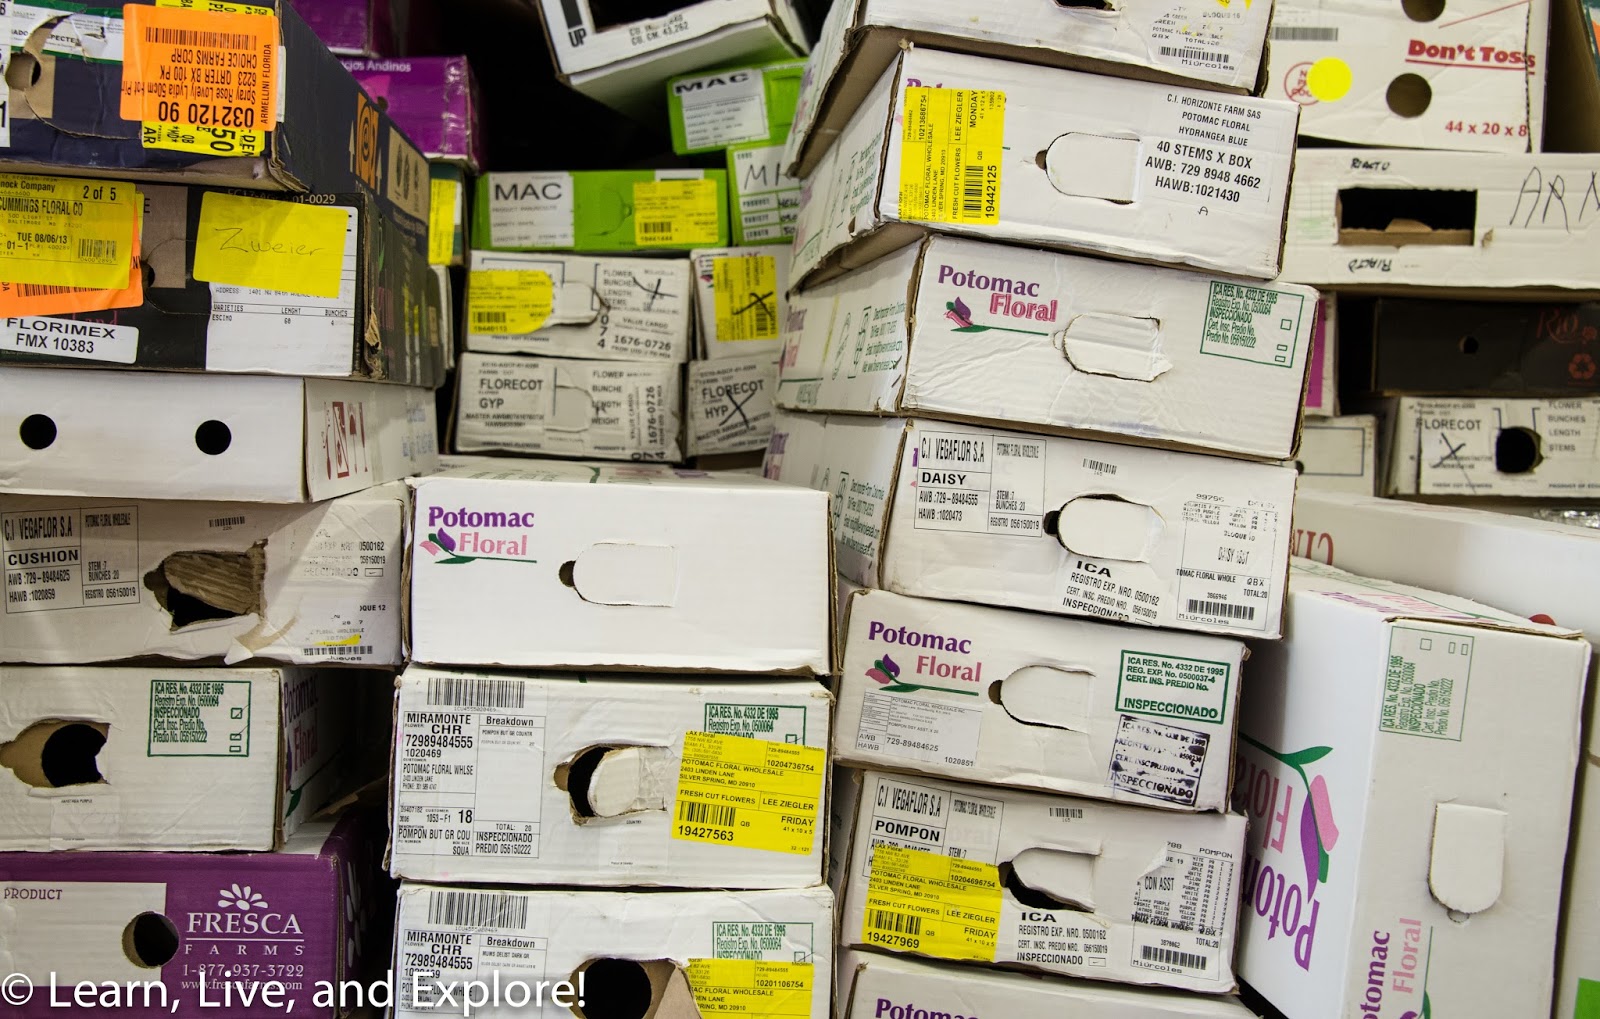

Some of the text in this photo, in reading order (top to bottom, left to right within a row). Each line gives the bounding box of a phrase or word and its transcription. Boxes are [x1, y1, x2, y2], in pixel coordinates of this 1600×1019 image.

[568, 29, 586, 48] UP
[171, 48, 257, 69] CHOICE FARMS CORP
[1408, 39, 1536, 67] Don't Toss
[160, 65, 256, 86] 6223 QRTER BX 100 PK
[260, 44, 272, 124] ARMELLINI FLORIDA
[675, 72, 748, 95] MAC
[148, 81, 256, 104] Spray Rose Lovely Lydia 50cm
[158, 101, 254, 128] 032120 90
[970, 90, 978, 128] MONDAY
[1167, 94, 1261, 120] C.I. HORIZONTE FARM SAS
[1182, 112, 1250, 132] POTOMAC FLORAL
[1445, 121, 1527, 138] 44 x 20 x 8
[1179, 126, 1248, 146] HYDRANGEA BLUE
[1157, 140, 1252, 169] 40 STEMS X BOX
[1145, 156, 1260, 189] AWB: 729 8948 4662
[20, 181, 116, 200] Company 2 of 5
[495, 183, 562, 200] MAC
[986, 165, 997, 218] 19442125
[1156, 176, 1240, 202] HAWB:1021430
[42, 200, 82, 216] FLORAL CO
[18, 232, 68, 244] TUE 08/06/13
[215, 227, 326, 256] Zweier
[938, 264, 1058, 323] Potomac Floral
[6, 317, 116, 340] FLORIMEX
[16, 333, 94, 354] FMX 10383
[480, 378, 544, 390] FLORECOT
[702, 380, 764, 400] FLORECOT
[480, 398, 504, 410] GYP
[705, 404, 729, 419] HYP
[1416, 418, 1482, 430] FLORECOT
[922, 472, 966, 485] DAISY
[428, 506, 534, 528] Potomac
[458, 532, 528, 556] Floral
[8, 550, 79, 566] CUSHION
[1076, 560, 1112, 578] ICA
[869, 621, 972, 654] Potomac
[916, 655, 982, 682] Floral
[1128, 656, 1142, 665] ICA
[1143, 658, 1160, 667] RES.
[1162, 661, 1174, 669] No.
[1176, 662, 1193, 670] 4332
[1206, 666, 1224, 676] 1995
[1124, 698, 1218, 718] INSPECCIONADO
[407, 713, 471, 724] MIRAMONTE
[486, 716, 534, 727] Breakdown
[432, 724, 462, 734] CHR
[406, 734, 473, 748] 72989484555
[405, 748, 442, 758] 1020469
[403, 763, 474, 776] POTOMAC FLORAL WHLSE
[682, 758, 714, 768] POTOMAC
[744, 766, 784, 776] WHOLESALE
[767, 760, 814, 772] 10204736754
[680, 790, 756, 804] FRESH CUT FLOWERS
[762, 798, 814, 811] LEE ZIEGLER
[458, 809, 472, 824] 18
[781, 815, 814, 827] FRIDAY
[398, 828, 470, 840] POMPON BUT GR COU
[476, 832, 532, 843] INSPECCIONADO
[678, 825, 734, 842] 19427563
[875, 820, 940, 842] POMPON
[476, 842, 532, 854] PREDIO 056150222
[4, 888, 62, 901] PRODUCT
[869, 898, 891, 907] FRESH
[908, 904, 940, 916] FLOWERS
[186, 912, 303, 936] FRESCA
[946, 910, 996, 924] LEE ZIEGLER
[1021, 912, 1057, 923] ICA
[407, 931, 472, 945] MIRAMONTE
[867, 931, 920, 949] 19427969
[964, 926, 996, 939] FRIDAY
[1018, 924, 1106, 940] REGISTRO EXP. NRO. 0500162
[431, 944, 462, 956] CHR
[487, 936, 535, 948] Breakdown
[405, 953, 472, 970] 72989484555
[1017, 952, 1083, 965] INSPECCIONADO
[1392, 917, 1422, 994] Floral
[733, 988, 774, 996] WHOLESALE
[756, 979, 804, 988] 10201106754
